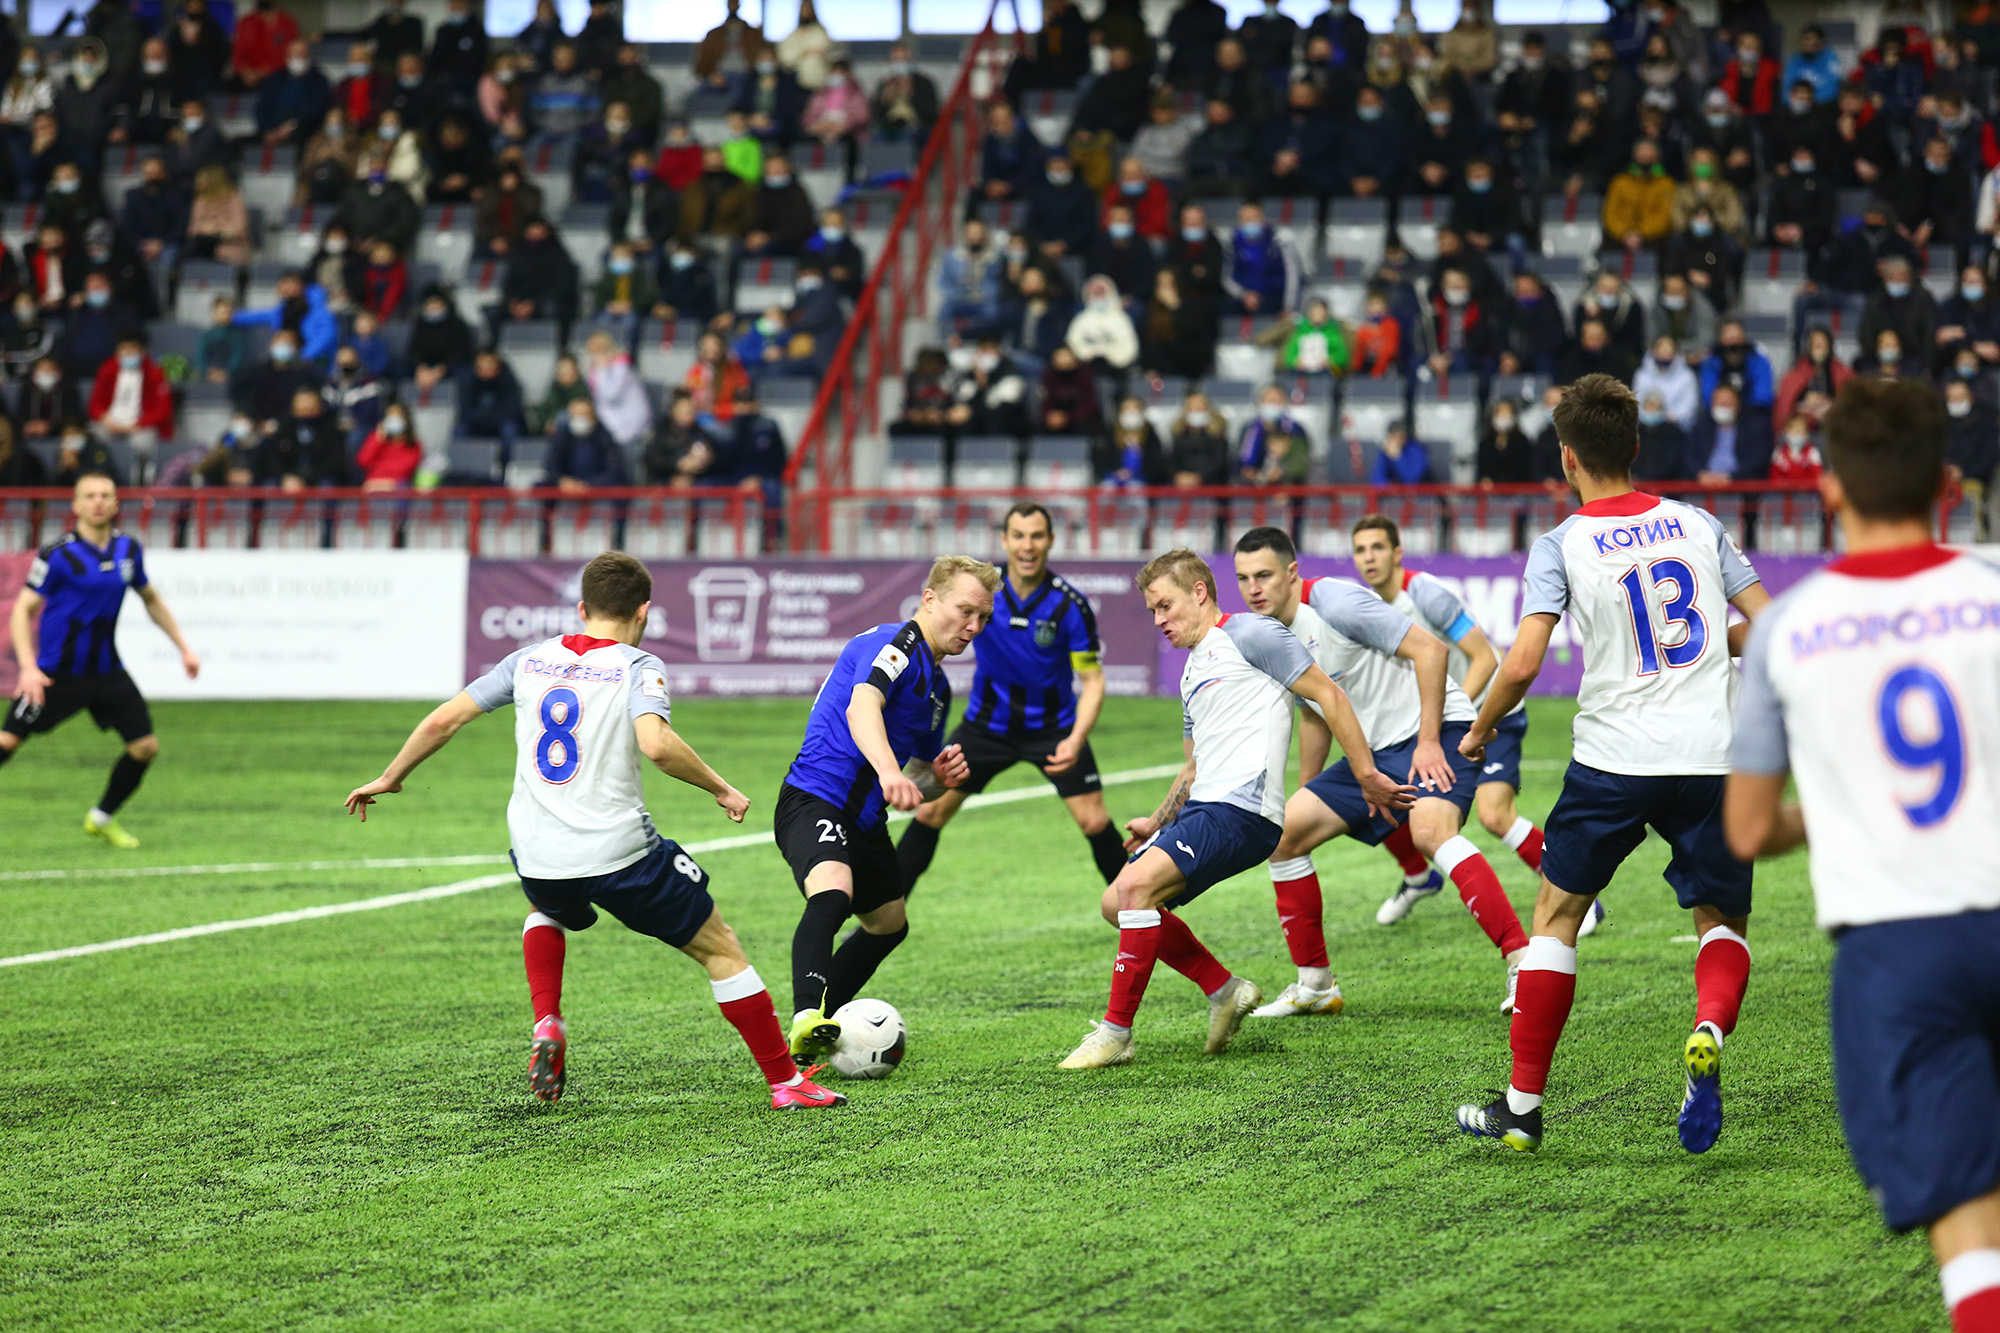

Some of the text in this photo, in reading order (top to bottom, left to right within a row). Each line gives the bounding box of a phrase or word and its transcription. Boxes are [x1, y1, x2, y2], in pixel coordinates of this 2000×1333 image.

[1590, 516, 1687, 557] КОТИН
[1618, 557, 1709, 677] 13
[533, 684, 584, 785] 8
[1872, 660, 1967, 832] 9
[673, 853, 702, 883] 8
[1115, 963, 1125, 972] 20
